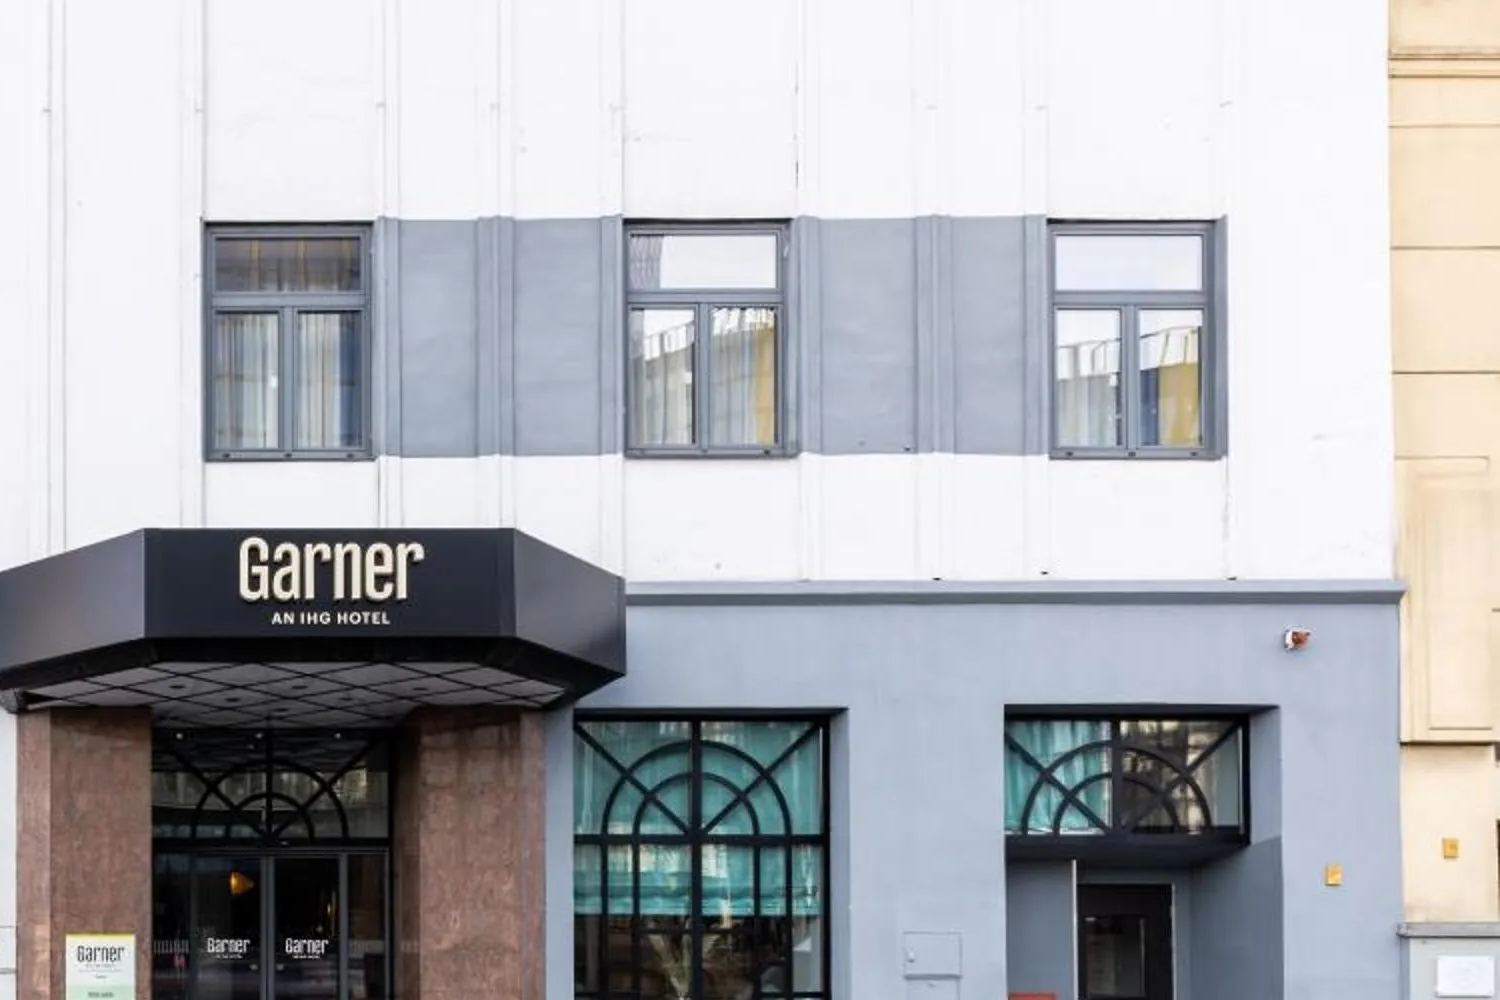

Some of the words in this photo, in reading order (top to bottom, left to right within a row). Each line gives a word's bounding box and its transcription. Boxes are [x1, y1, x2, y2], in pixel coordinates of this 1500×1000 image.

[239, 536, 425, 601] Garner
[271, 611, 295, 625] AN
[300, 611, 331, 625] IHG
[336, 611, 391, 625] HOTEL
[77, 945, 125, 963] Garner
